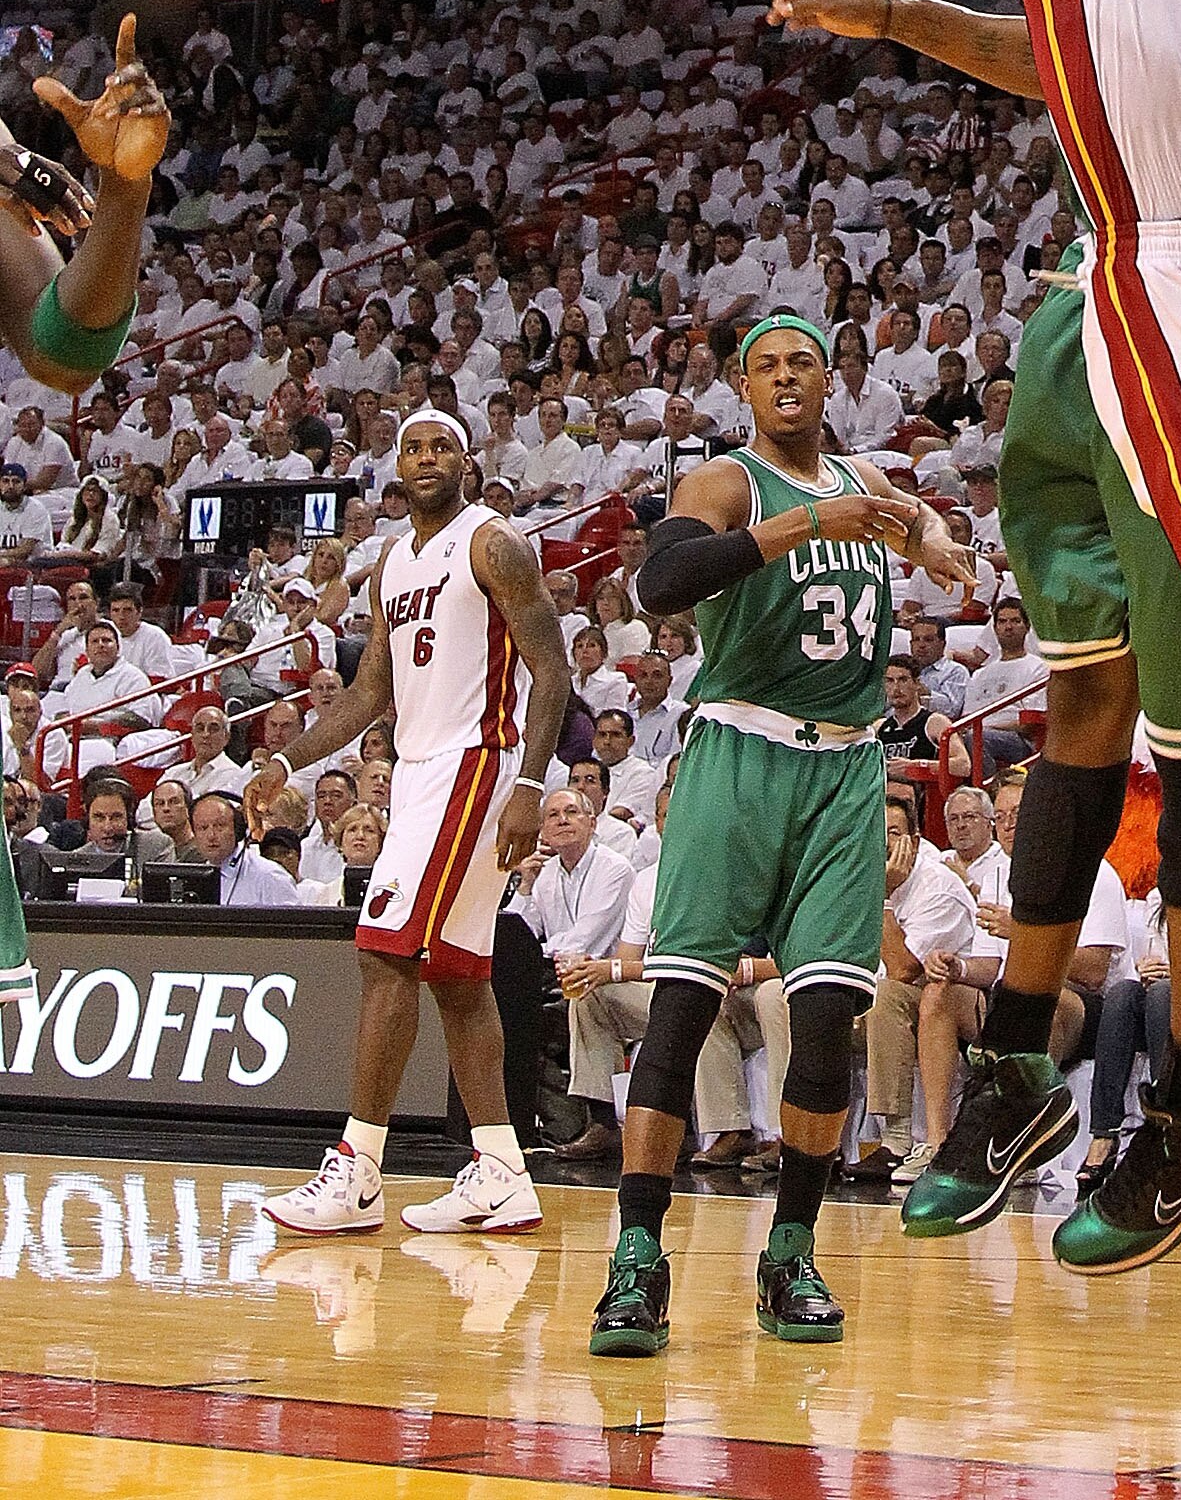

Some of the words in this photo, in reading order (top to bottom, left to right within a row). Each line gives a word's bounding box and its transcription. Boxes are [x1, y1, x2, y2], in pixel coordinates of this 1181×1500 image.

[194, 541, 216, 554] HEAT
[788, 537, 885, 585] CELTICS
[386, 572, 451, 633] HEAT
[801, 584, 877, 661] 34
[412, 626, 437, 668] 6
[884, 735, 918, 760] EAT
[0, 967, 298, 1087] YOFFS
